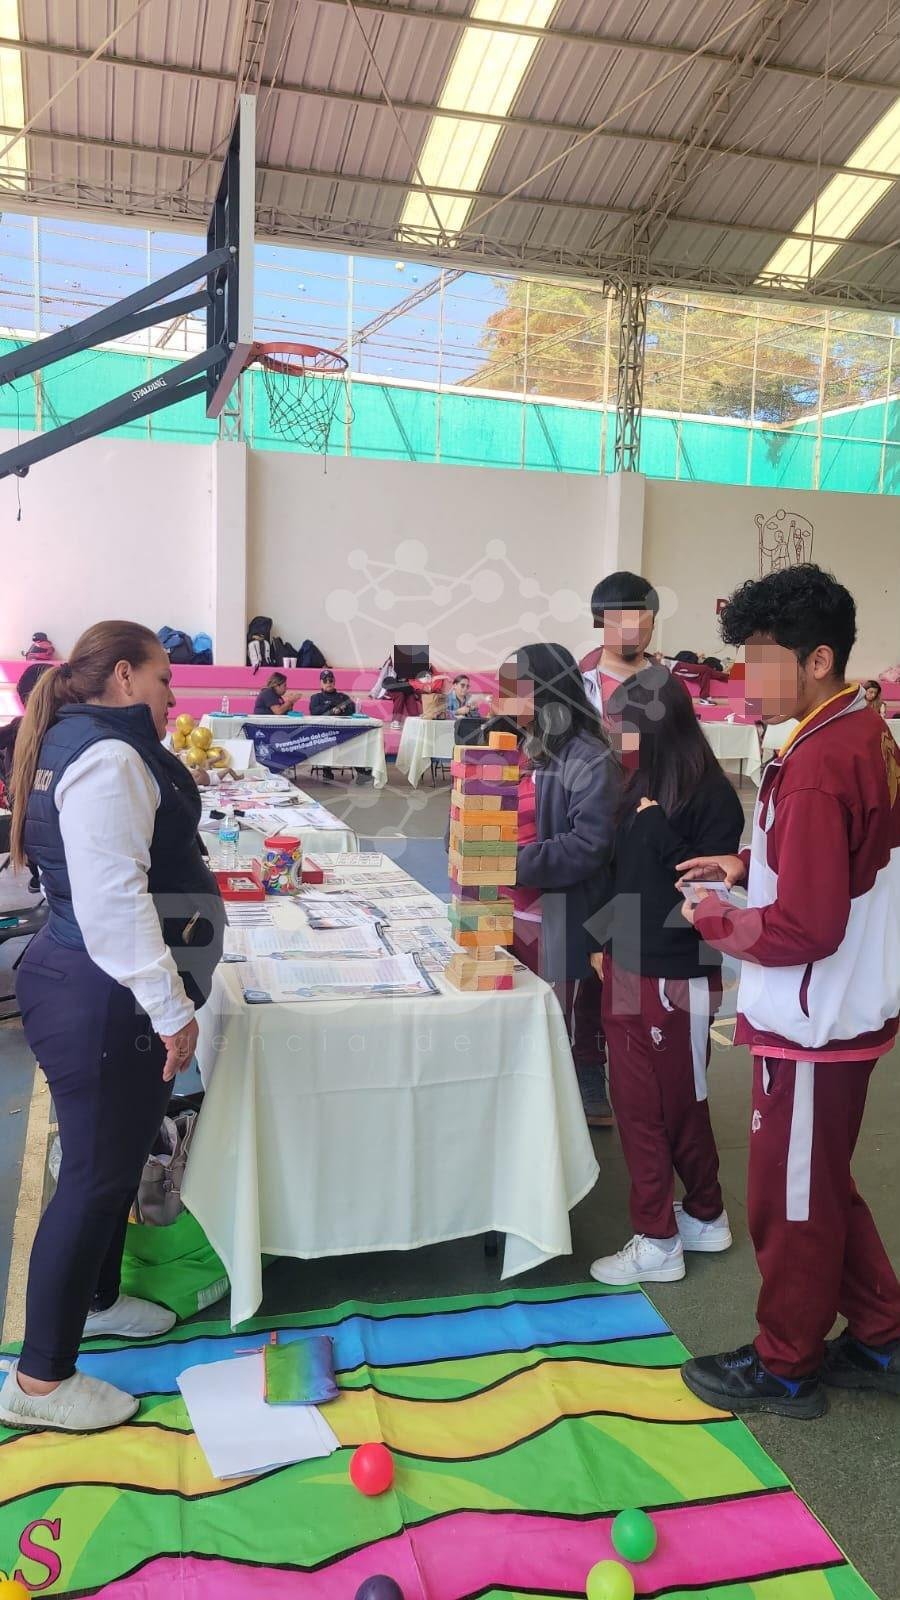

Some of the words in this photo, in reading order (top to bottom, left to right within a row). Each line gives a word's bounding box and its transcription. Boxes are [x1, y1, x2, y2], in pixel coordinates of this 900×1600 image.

[131, 377, 167, 401] SPALDING
[275, 736, 310, 748] Prevención
[281, 741, 313, 752] Seguridad
